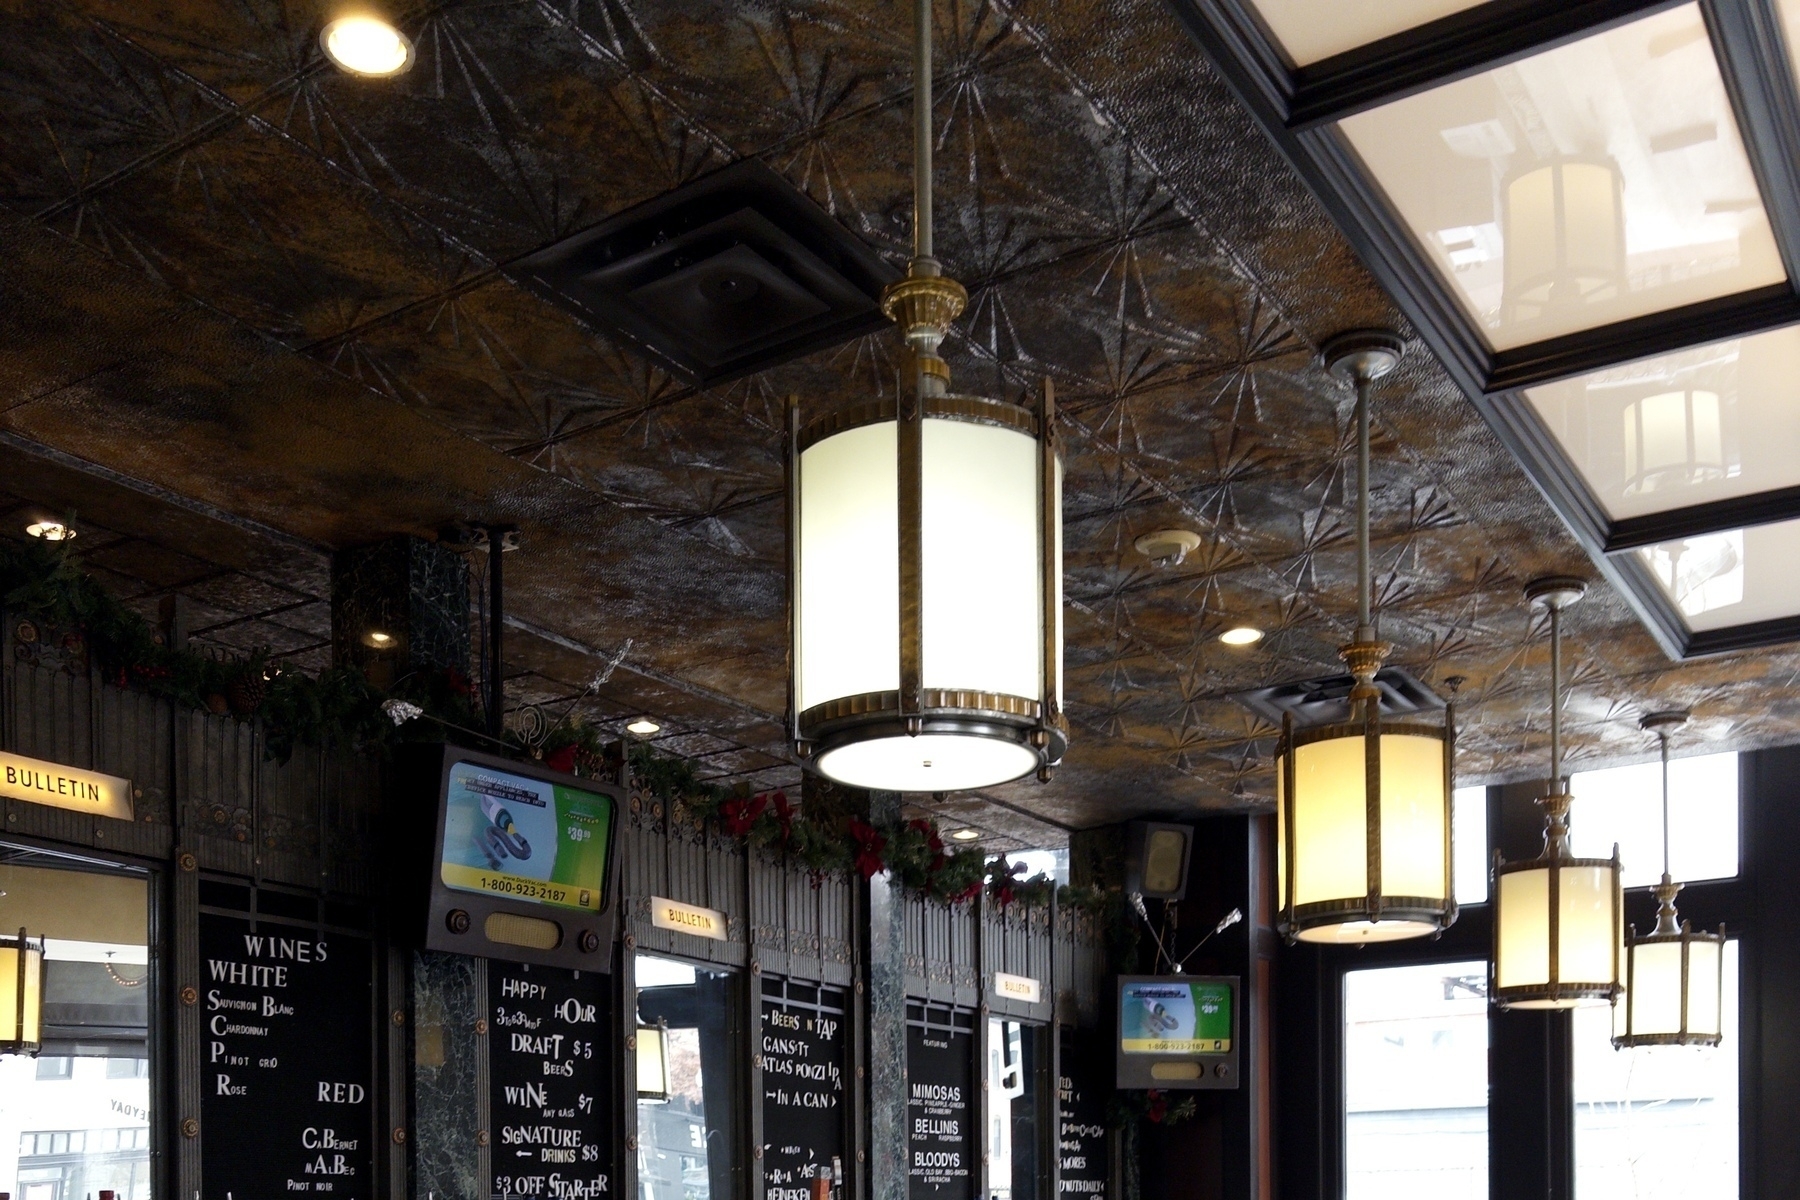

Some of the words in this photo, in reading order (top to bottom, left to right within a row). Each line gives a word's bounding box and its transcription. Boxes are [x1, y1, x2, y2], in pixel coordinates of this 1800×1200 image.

[6, 765, 99, 802] BULLETIN
[480, 877, 566, 902] 1-800-923-2187
[668, 908, 712, 930] BULLETIN
[243, 934, 328, 963] WINES
[208, 959, 288, 988] WHITE
[502, 977, 547, 1000] HAPPY
[262, 995, 295, 1017] BLANC
[554, 998, 597, 1024] HOUR
[210, 1015, 269, 1036] CHARDONNAY
[771, 1009, 800, 1031] BEERS
[815, 1018, 837, 1041] TAP
[210, 1041, 250, 1066] PINOT
[511, 1033, 564, 1060] DRAFT
[543, 1059, 575, 1078] BEERS
[761, 1055, 793, 1075] ATLAS
[796, 1062, 826, 1081] PONZI
[828, 1061, 842, 1090] IPA
[216, 1074, 247, 1096] ROSE
[317, 1081, 365, 1104] RED
[912, 1082, 961, 1102] MIMOSAS
[504, 1081, 548, 1109] WINE
[578, 1092, 593, 1115] $7
[777, 1088, 789, 1106] IN
[792, 1091, 801, 1107] A
[803, 1091, 829, 1108] CAN
[502, 1125, 582, 1147] SIGNATURE
[911, 1133, 927, 1141] PEACH
[915, 1118, 959, 1135] BELLINIS
[302, 1127, 358, 1151] CABERNET
[304, 1153, 356, 1176] MALBEC
[541, 1148, 577, 1163] DRINKS
[582, 1144, 599, 1161] $8
[914, 1151, 961, 1168] BLOODYS
[286, 1178, 310, 1192] PINOT
[496, 1175, 511, 1194] $3
[515, 1176, 545, 1195] OFF
